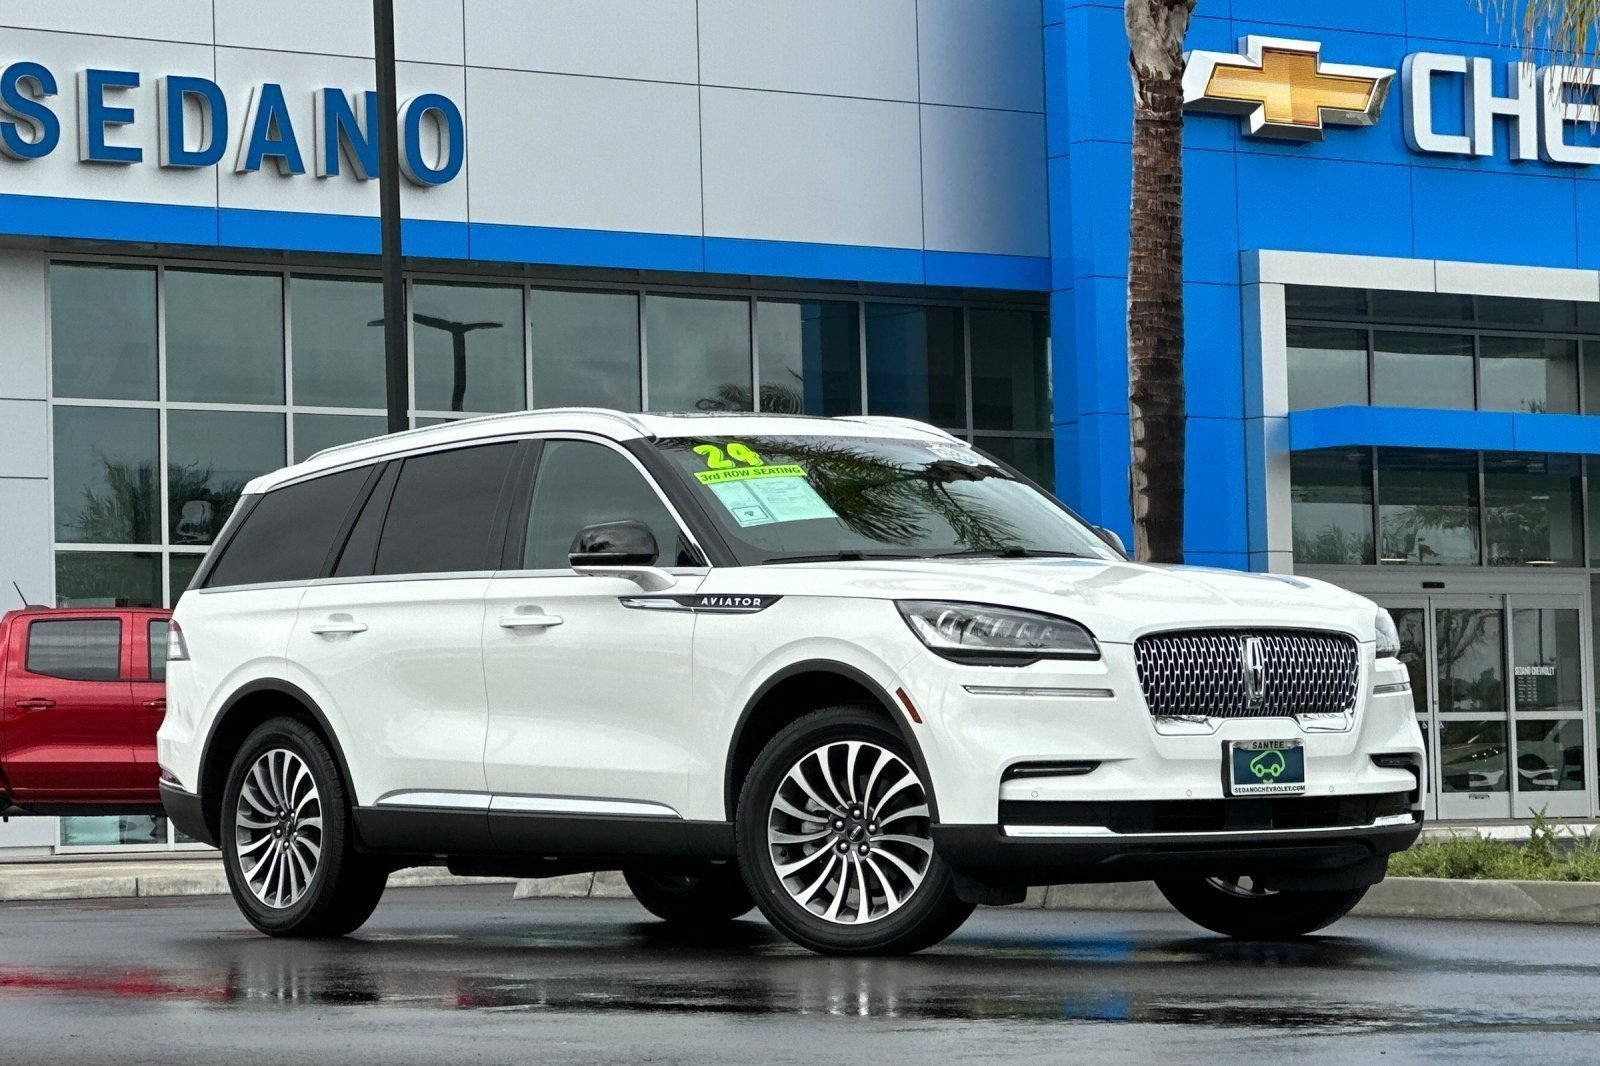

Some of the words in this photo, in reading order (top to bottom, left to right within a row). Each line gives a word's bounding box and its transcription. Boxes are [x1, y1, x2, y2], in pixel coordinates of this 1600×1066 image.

[0, 61, 465, 188] SEDANO
[693, 443, 764, 469] 24
[700, 472, 720, 482] 3rd
[724, 469, 751, 479] ROW
[753, 467, 802, 477] SEATING
[701, 597, 762, 606] AVIATOR
[1252, 741, 1285, 749] SANTEE
[1234, 785, 1306, 794] SEDANOCHEVROLET.COM
